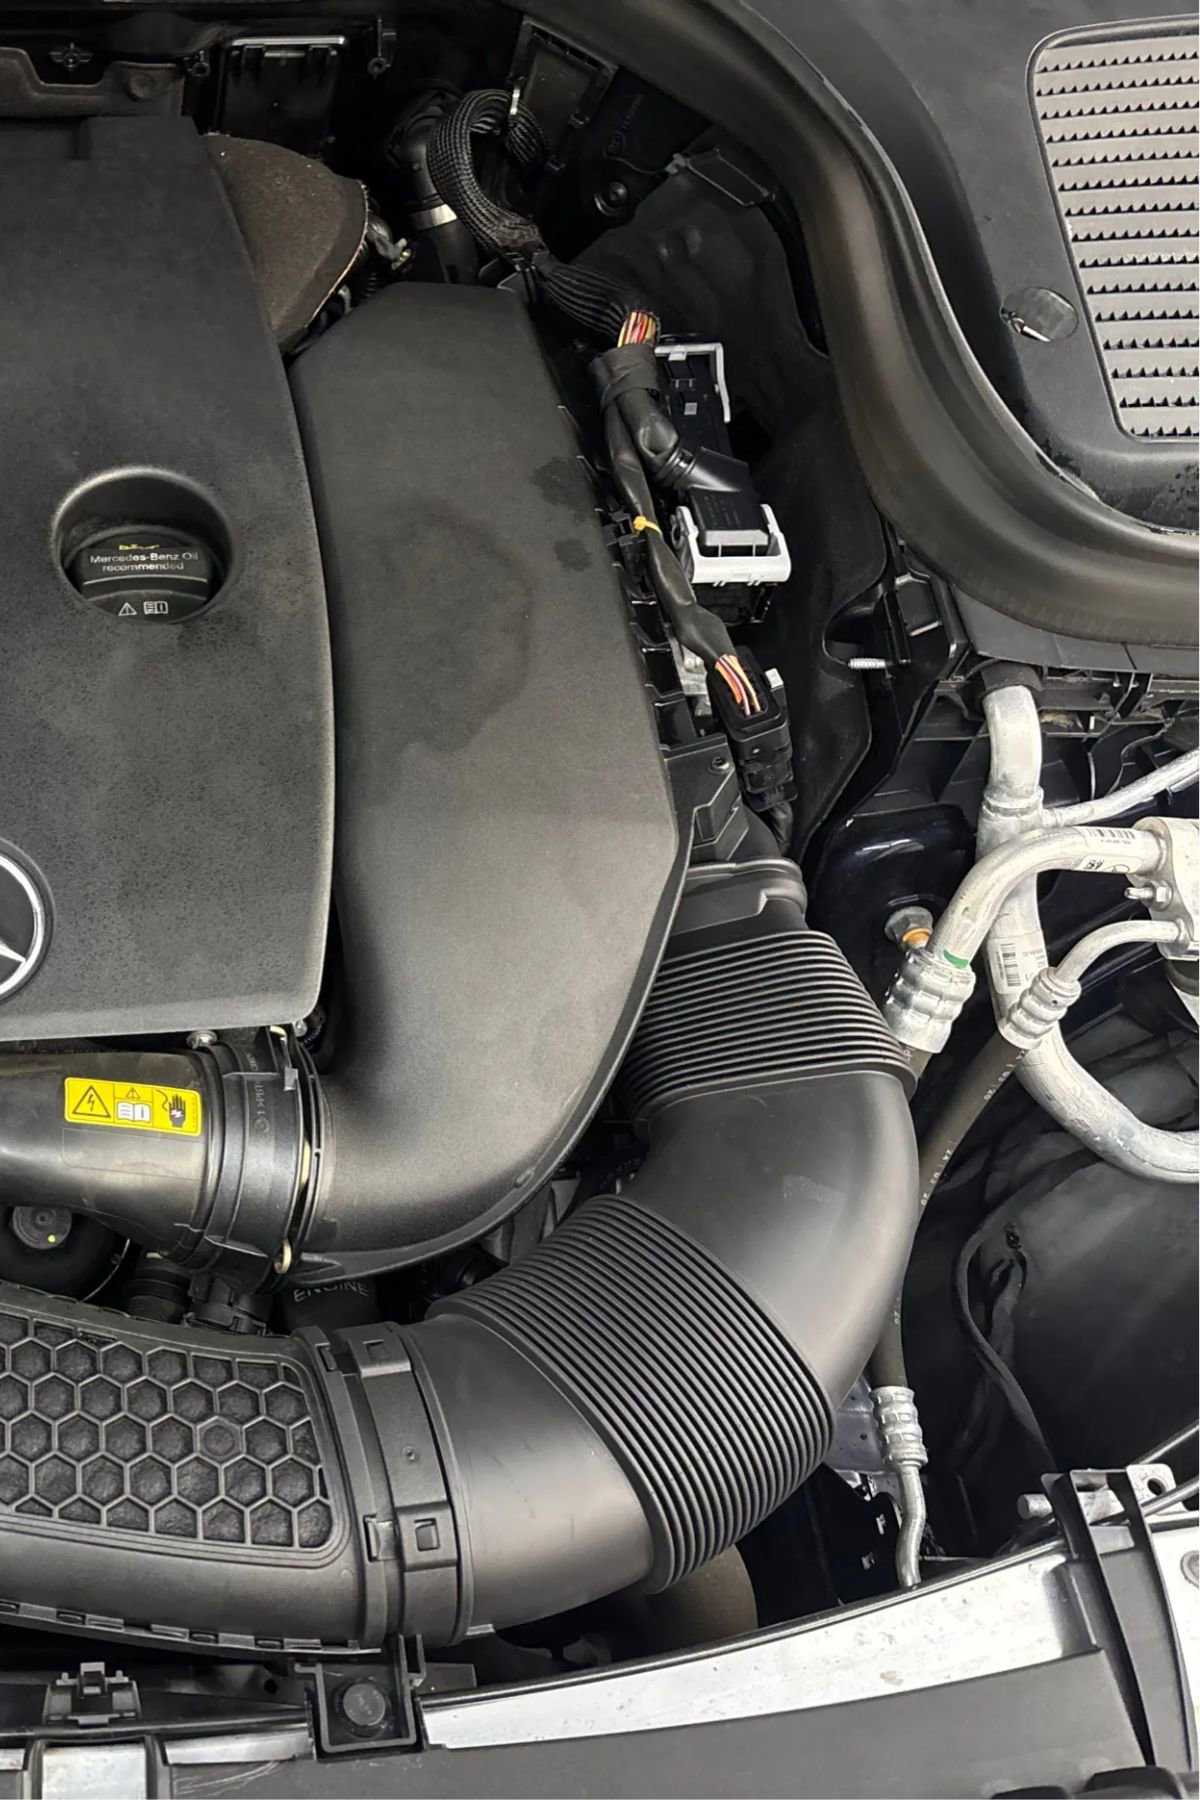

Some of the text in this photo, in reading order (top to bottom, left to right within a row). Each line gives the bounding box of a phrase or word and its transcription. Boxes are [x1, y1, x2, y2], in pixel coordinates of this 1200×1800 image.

[90, 552, 198, 563] Mercedes-Benz Oil
[102, 562, 184, 572] recommended
